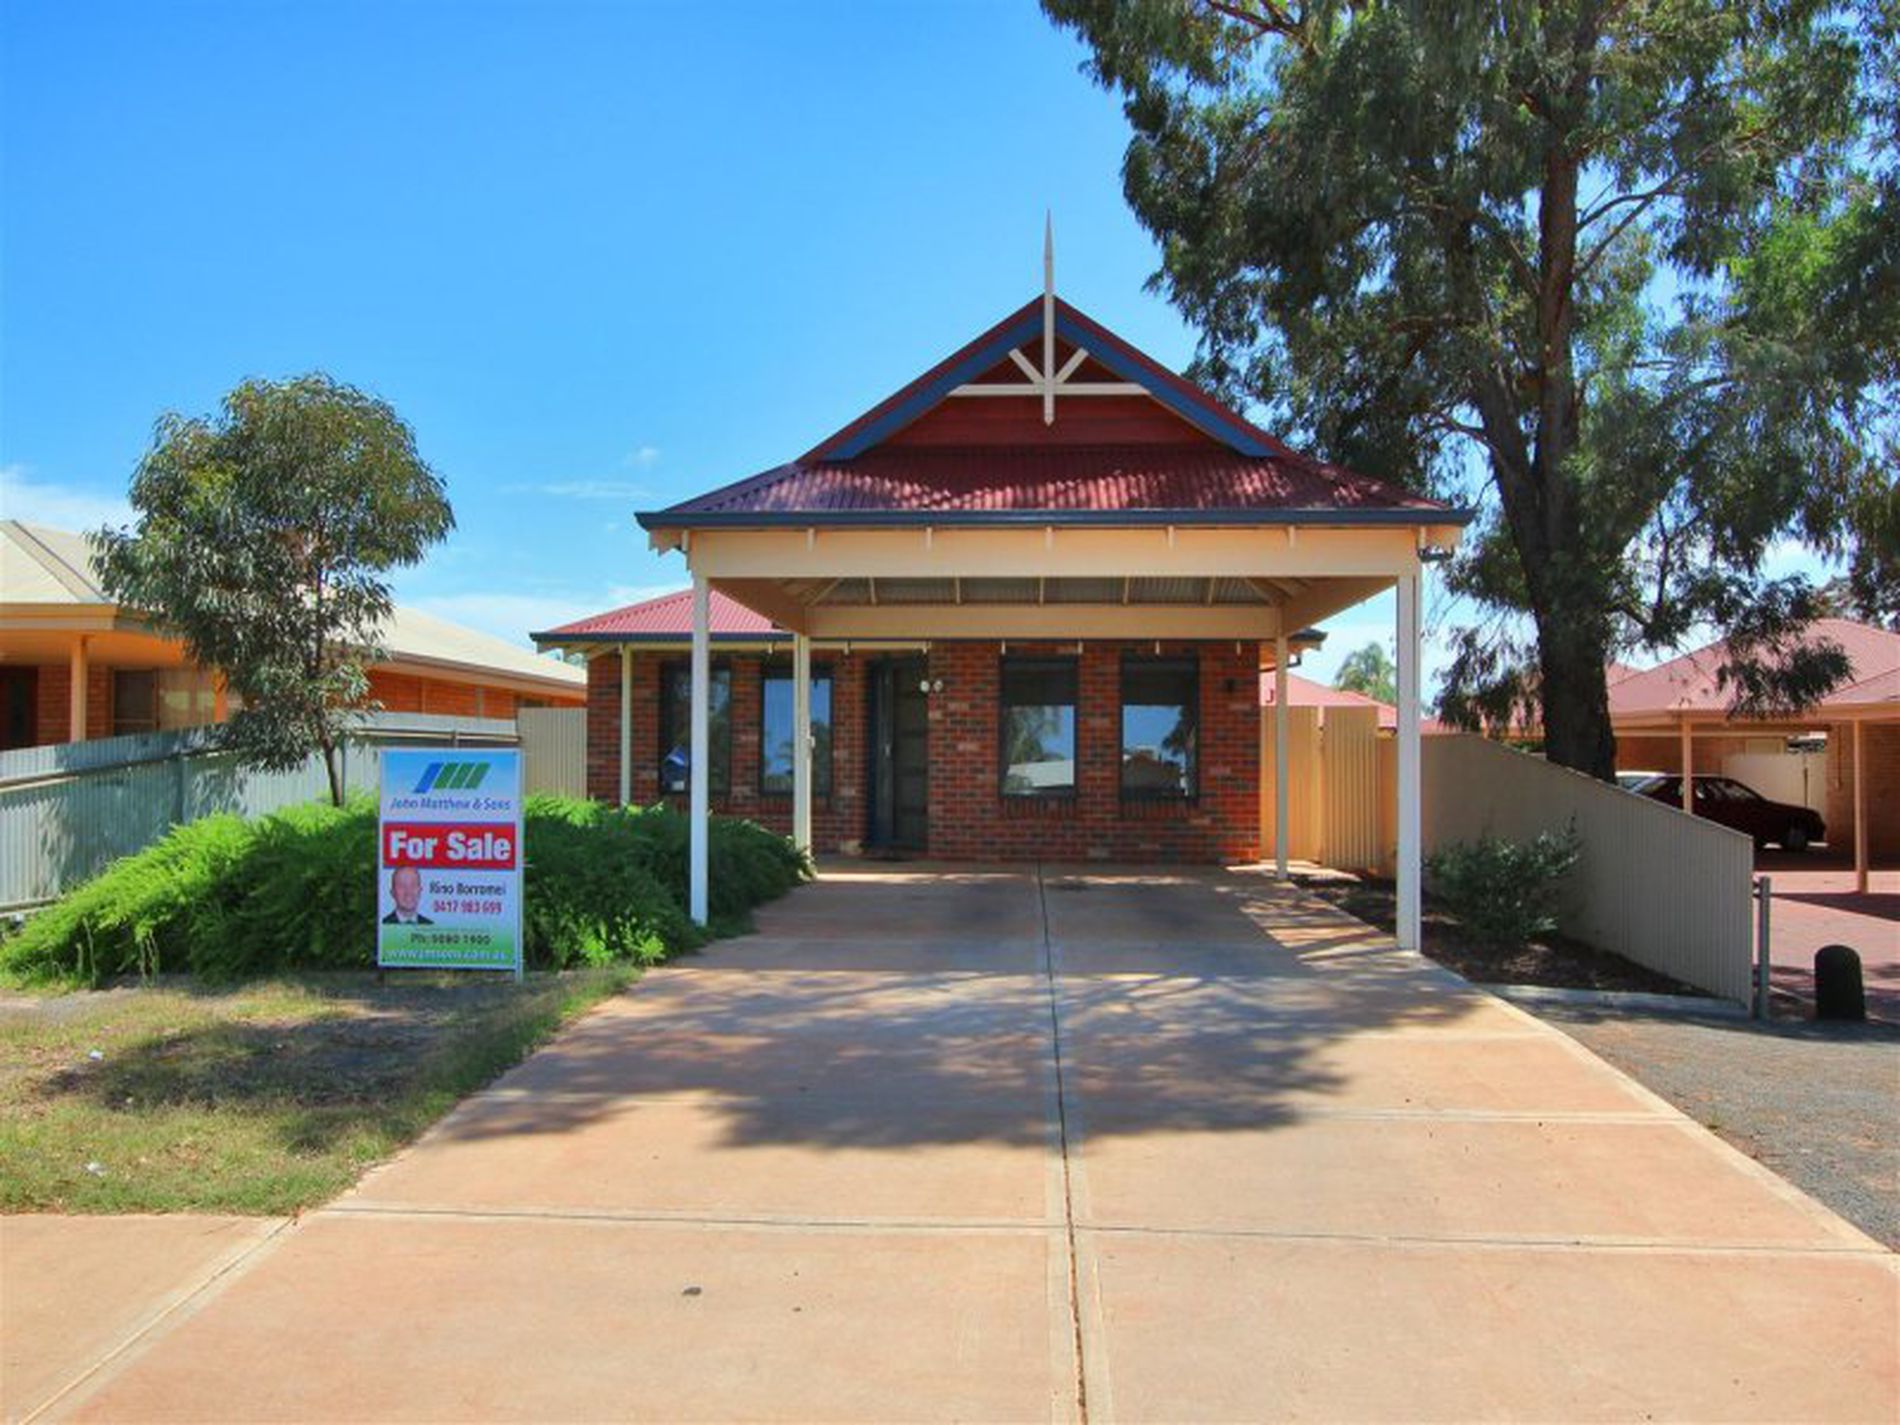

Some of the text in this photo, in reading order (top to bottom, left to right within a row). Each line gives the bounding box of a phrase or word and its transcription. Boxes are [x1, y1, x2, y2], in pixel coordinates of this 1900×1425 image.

[472, 797, 482, 810] &
[390, 830, 511, 860] For Sale
